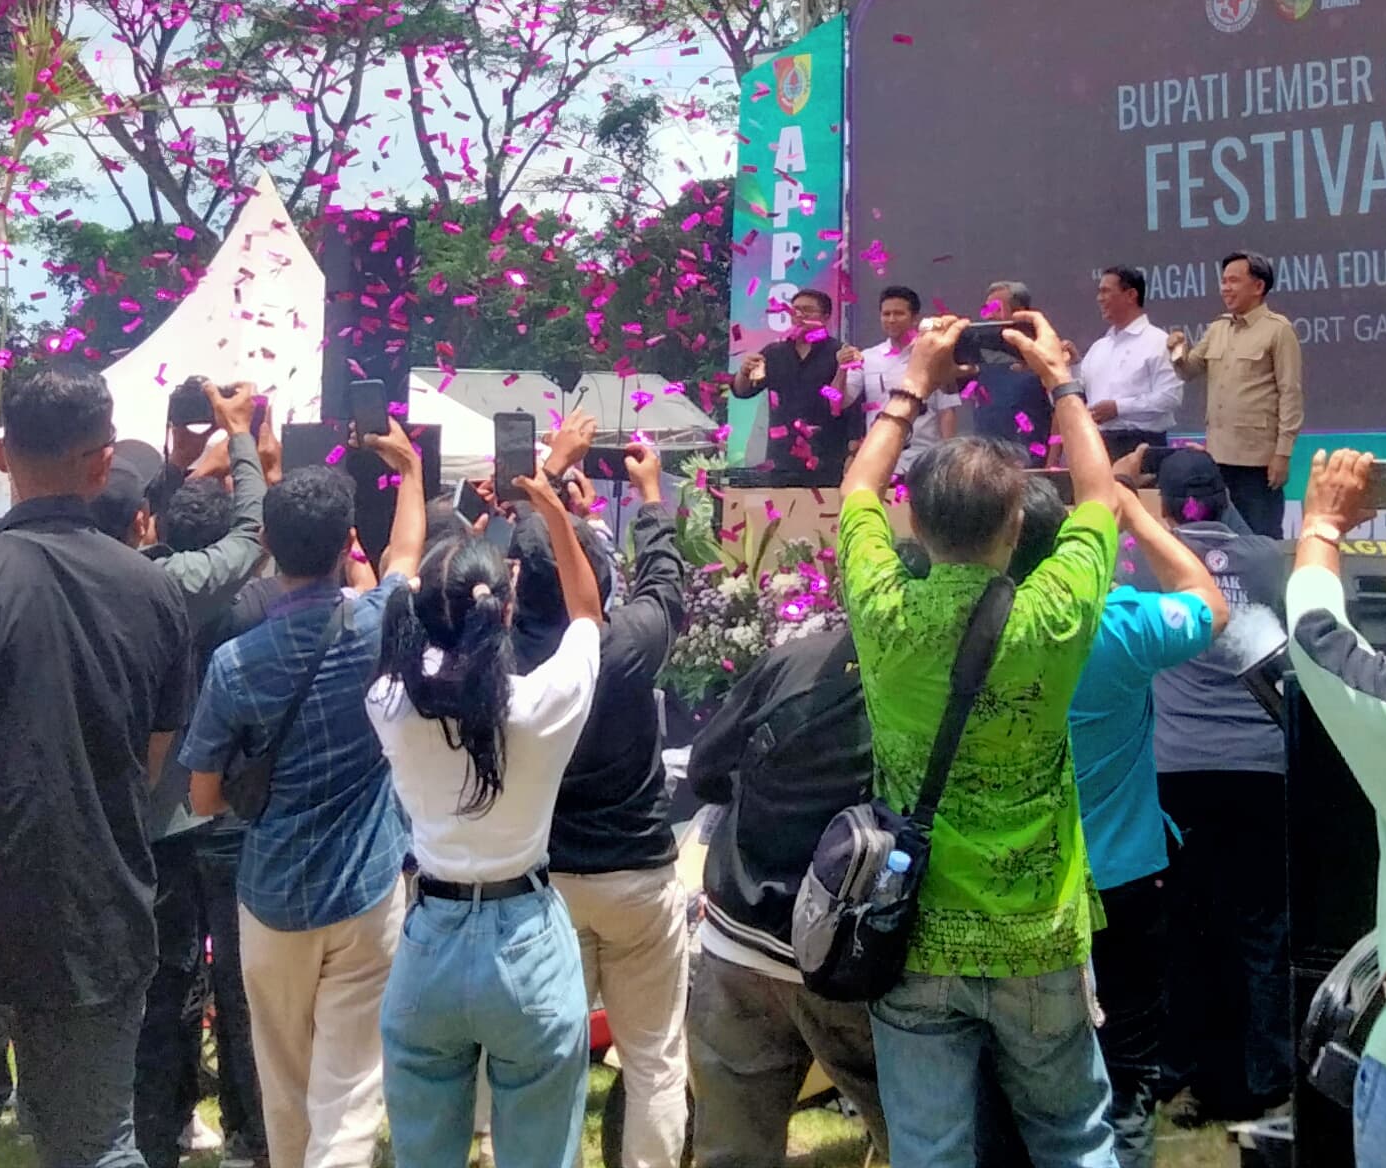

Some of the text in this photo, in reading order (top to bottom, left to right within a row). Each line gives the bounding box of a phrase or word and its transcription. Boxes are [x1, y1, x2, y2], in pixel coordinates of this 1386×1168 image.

[1117, 72, 1229, 132] BUPATI
[1241, 54, 1373, 118] JEMBER
[767, 126, 807, 332] APPS
[1299, 315, 1346, 344] ORT
